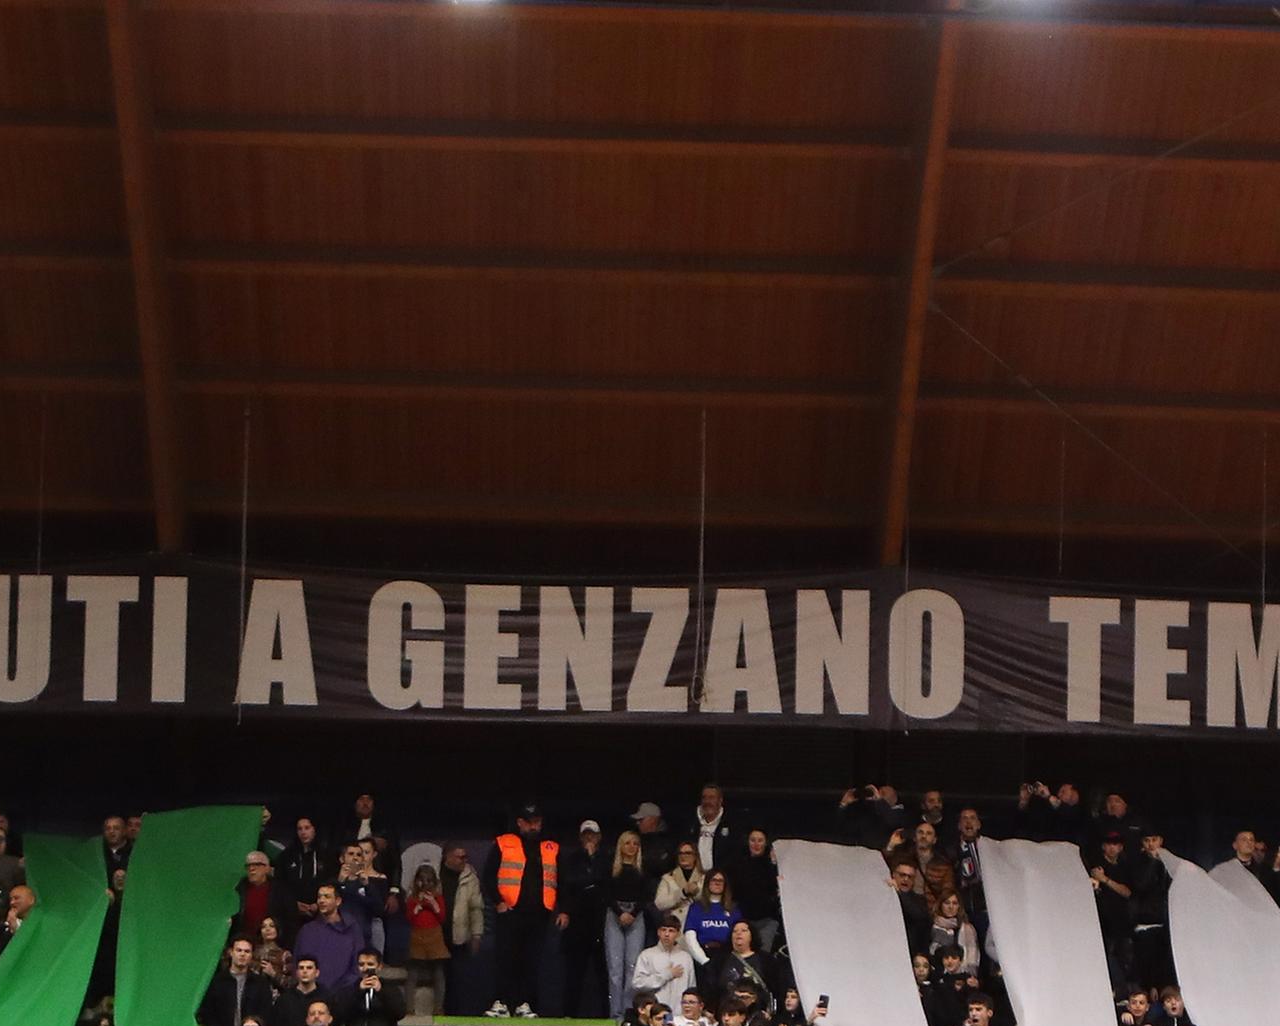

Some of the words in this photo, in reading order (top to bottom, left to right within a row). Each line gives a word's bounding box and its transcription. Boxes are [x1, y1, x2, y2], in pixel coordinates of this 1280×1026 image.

[234, 579, 318, 707] A
[365, 579, 965, 719] GENZANO
[702, 919, 729, 928] ITALIA
